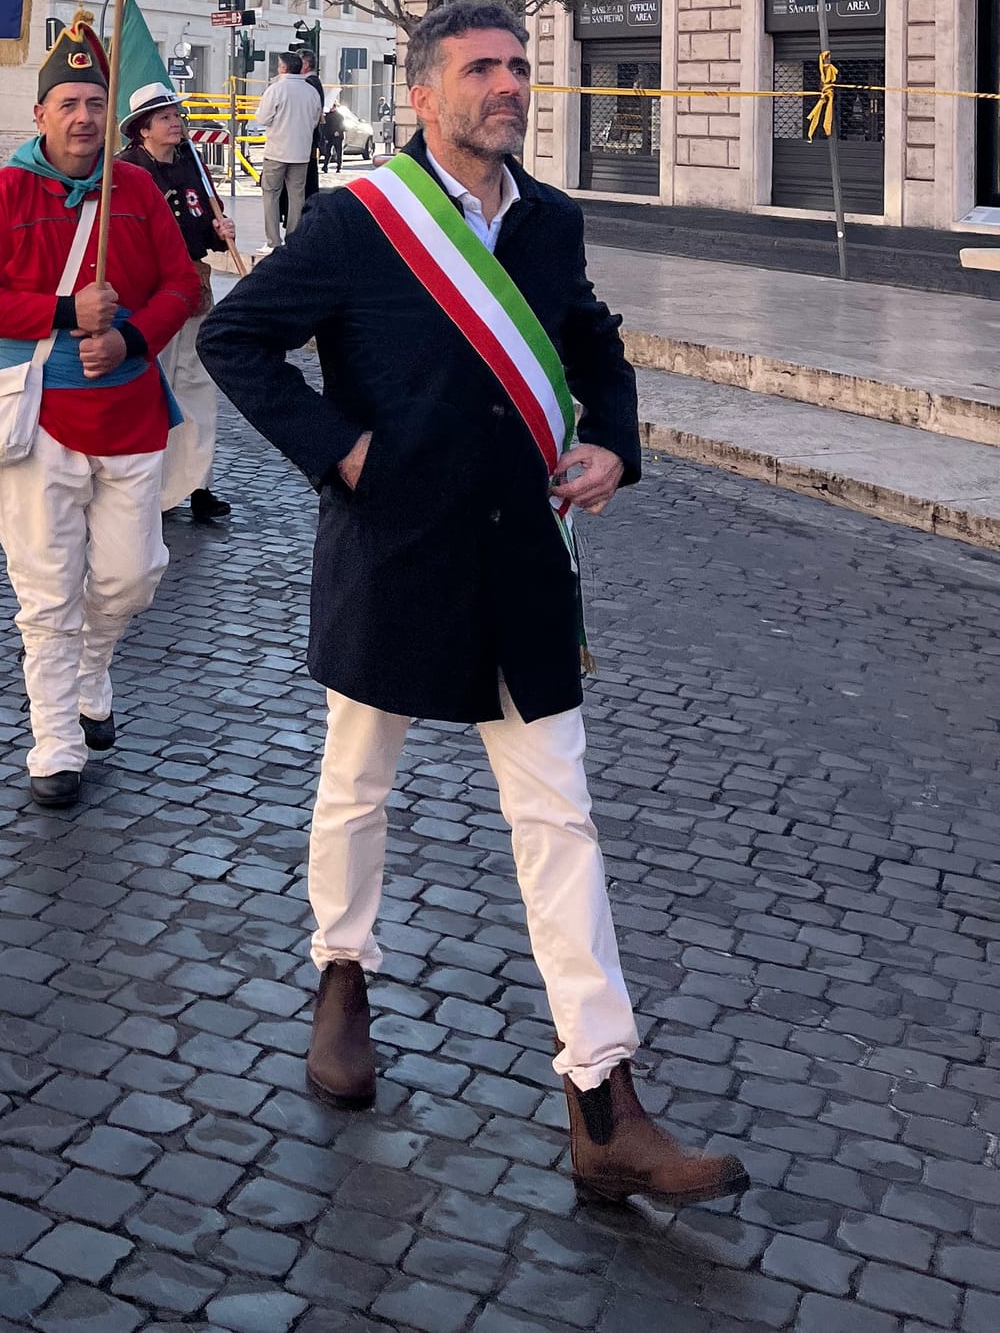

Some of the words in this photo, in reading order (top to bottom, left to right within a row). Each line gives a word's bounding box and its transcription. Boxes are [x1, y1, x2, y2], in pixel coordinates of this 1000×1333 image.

[629, 2, 657, 12] OFFICIAL
[788, 4, 804, 13] SAN
[847, 1, 870, 11] AREA
[591, 15, 603, 23] SAN
[603, 13, 624, 23] PIETRO
[634, 12, 653, 21] AREA
